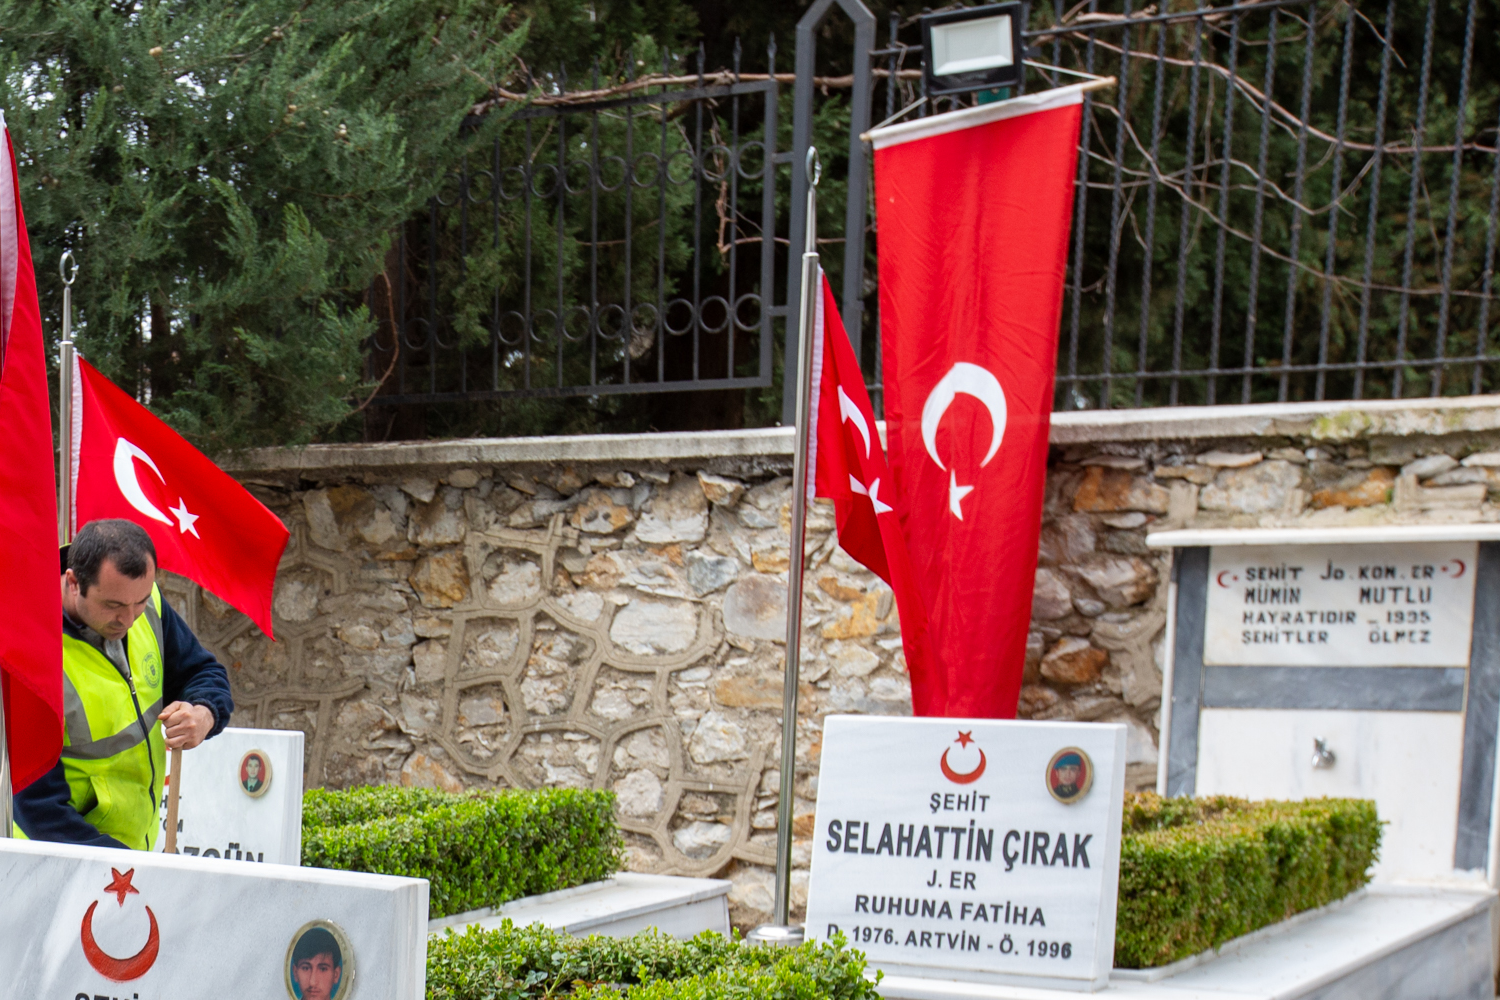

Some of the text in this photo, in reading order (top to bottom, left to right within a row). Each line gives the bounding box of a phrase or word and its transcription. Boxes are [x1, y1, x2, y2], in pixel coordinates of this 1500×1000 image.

[930, 790, 990, 814] ŞEHİT
[826, 819, 1093, 872] SELAHATTİN ÇIRAK
[927, 869, 976, 890] J. ER
[855, 894, 1046, 927] RUHUNA FATİHA
[827, 924, 839, 939] D
[853, 926, 898, 945] 1976.
[904, 930, 980, 952] ARTVİN
[999, 934, 1018, 955] Ö.
[1027, 940, 1072, 960] 1996
